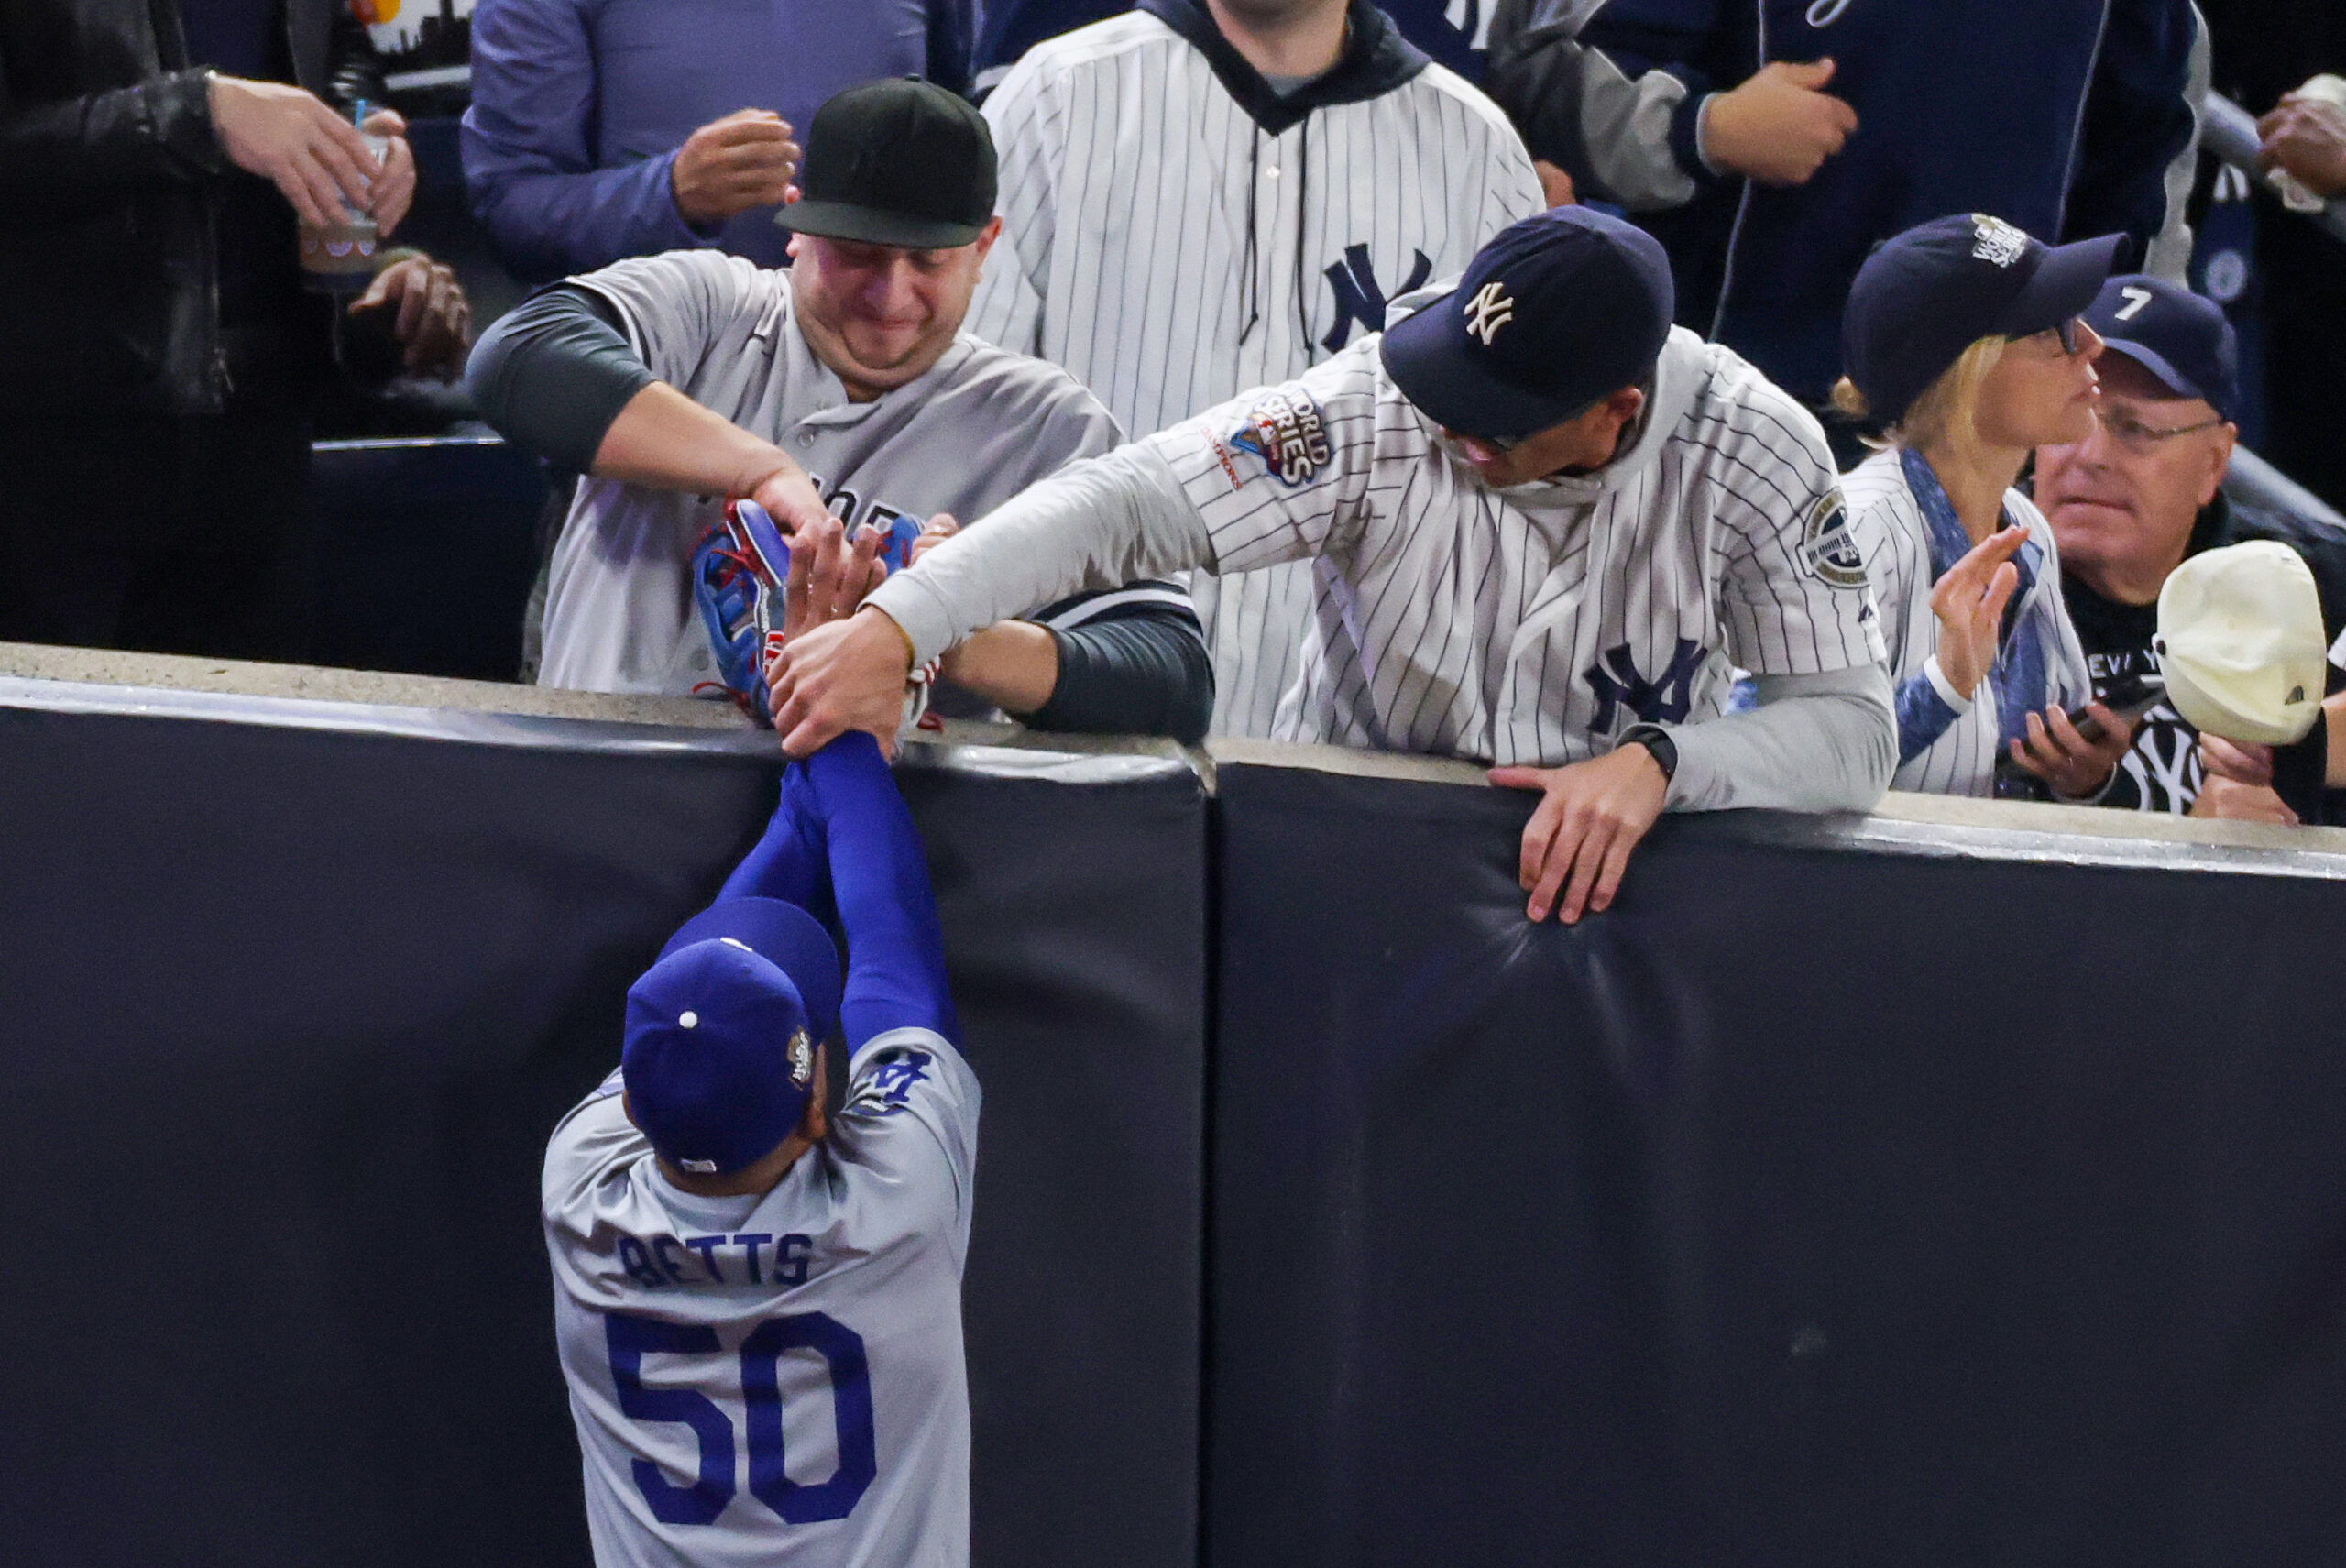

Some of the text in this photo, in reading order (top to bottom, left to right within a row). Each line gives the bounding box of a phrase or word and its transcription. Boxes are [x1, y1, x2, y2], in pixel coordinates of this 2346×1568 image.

[1464, 281, 1514, 345] NY
[2114, 286, 2153, 322] 7
[1255, 394, 1315, 486] SERIES
[1285, 388, 1331, 466] WORLD
[1583, 636, 1708, 735] NY
[617, 1232, 814, 1288] BETTS
[604, 1310, 877, 1526] 50
